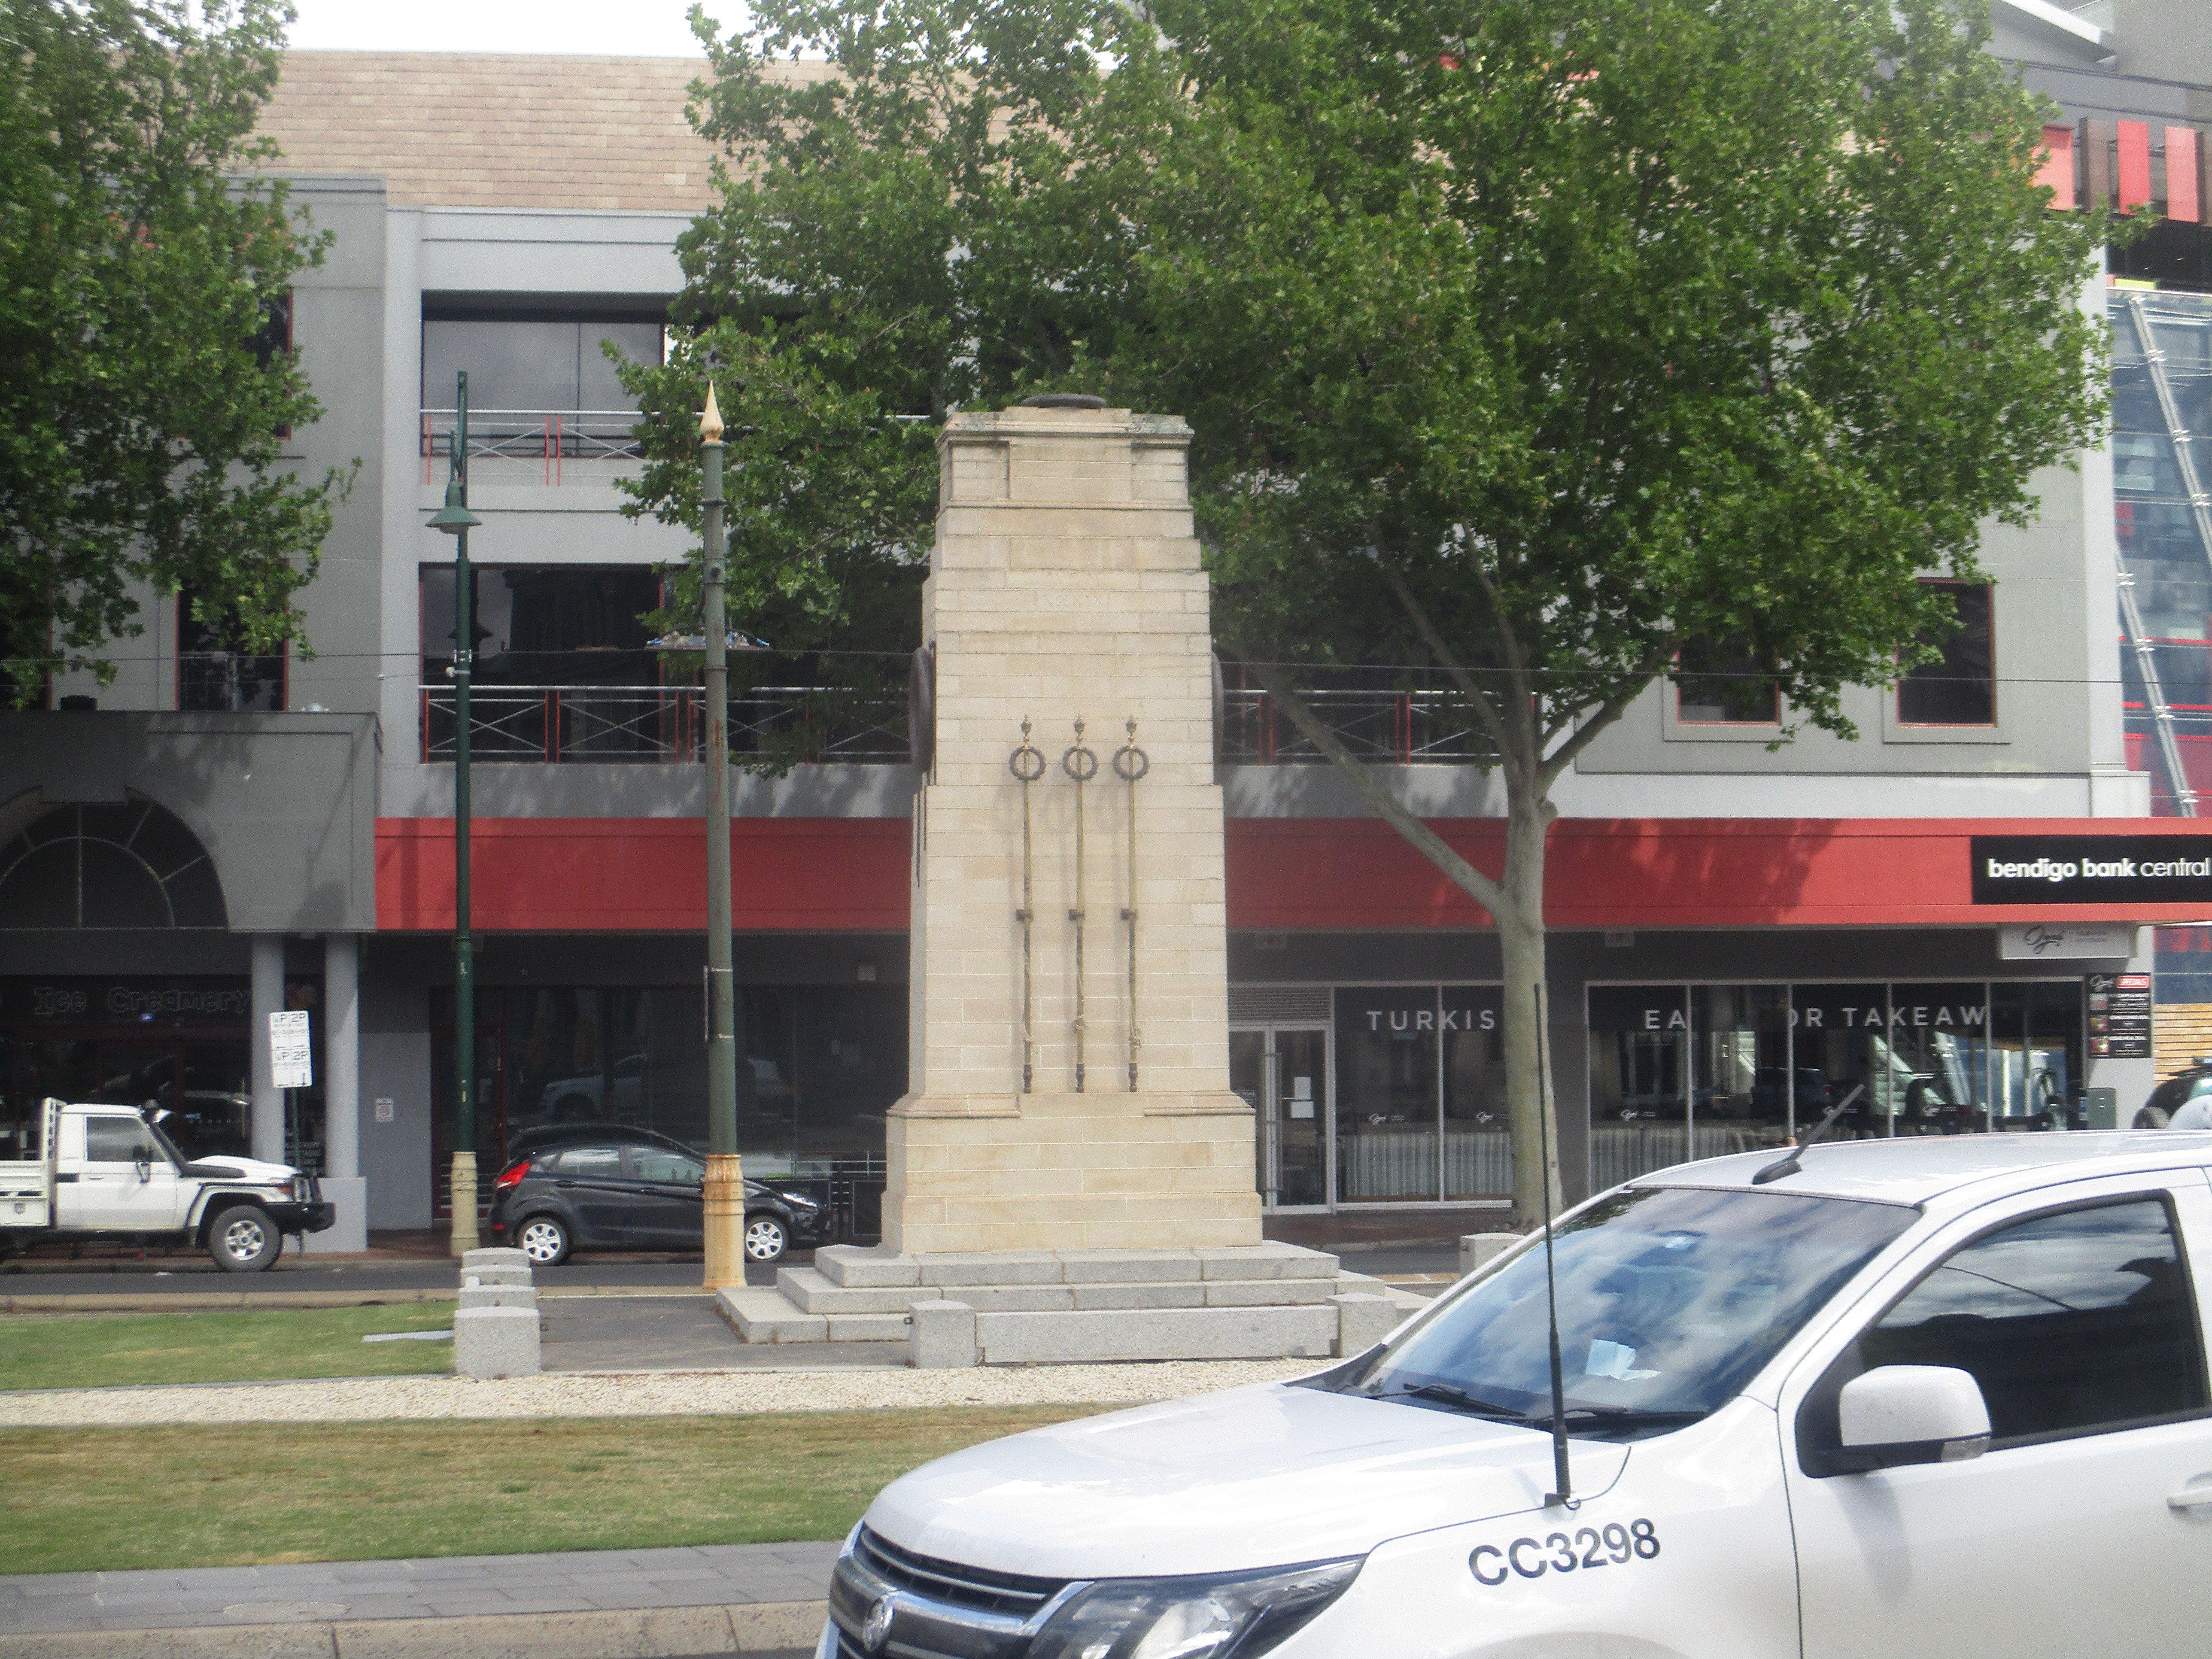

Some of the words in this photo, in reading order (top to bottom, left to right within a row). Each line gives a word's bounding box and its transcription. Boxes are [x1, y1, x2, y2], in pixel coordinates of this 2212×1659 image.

[1987, 857, 2077, 882] bendigo
[2082, 857, 2137, 877] bank
[2140, 857, 2212, 877] central
[34, 987, 87, 1015] Ice
[107, 986, 251, 1014] Creamery
[291, 1012, 307, 1023] 2P
[1366, 1009, 1495, 1030] TURKIS
[293, 1051, 309, 1060] 2P
[1468, 1518, 1661, 1586] CC3298
